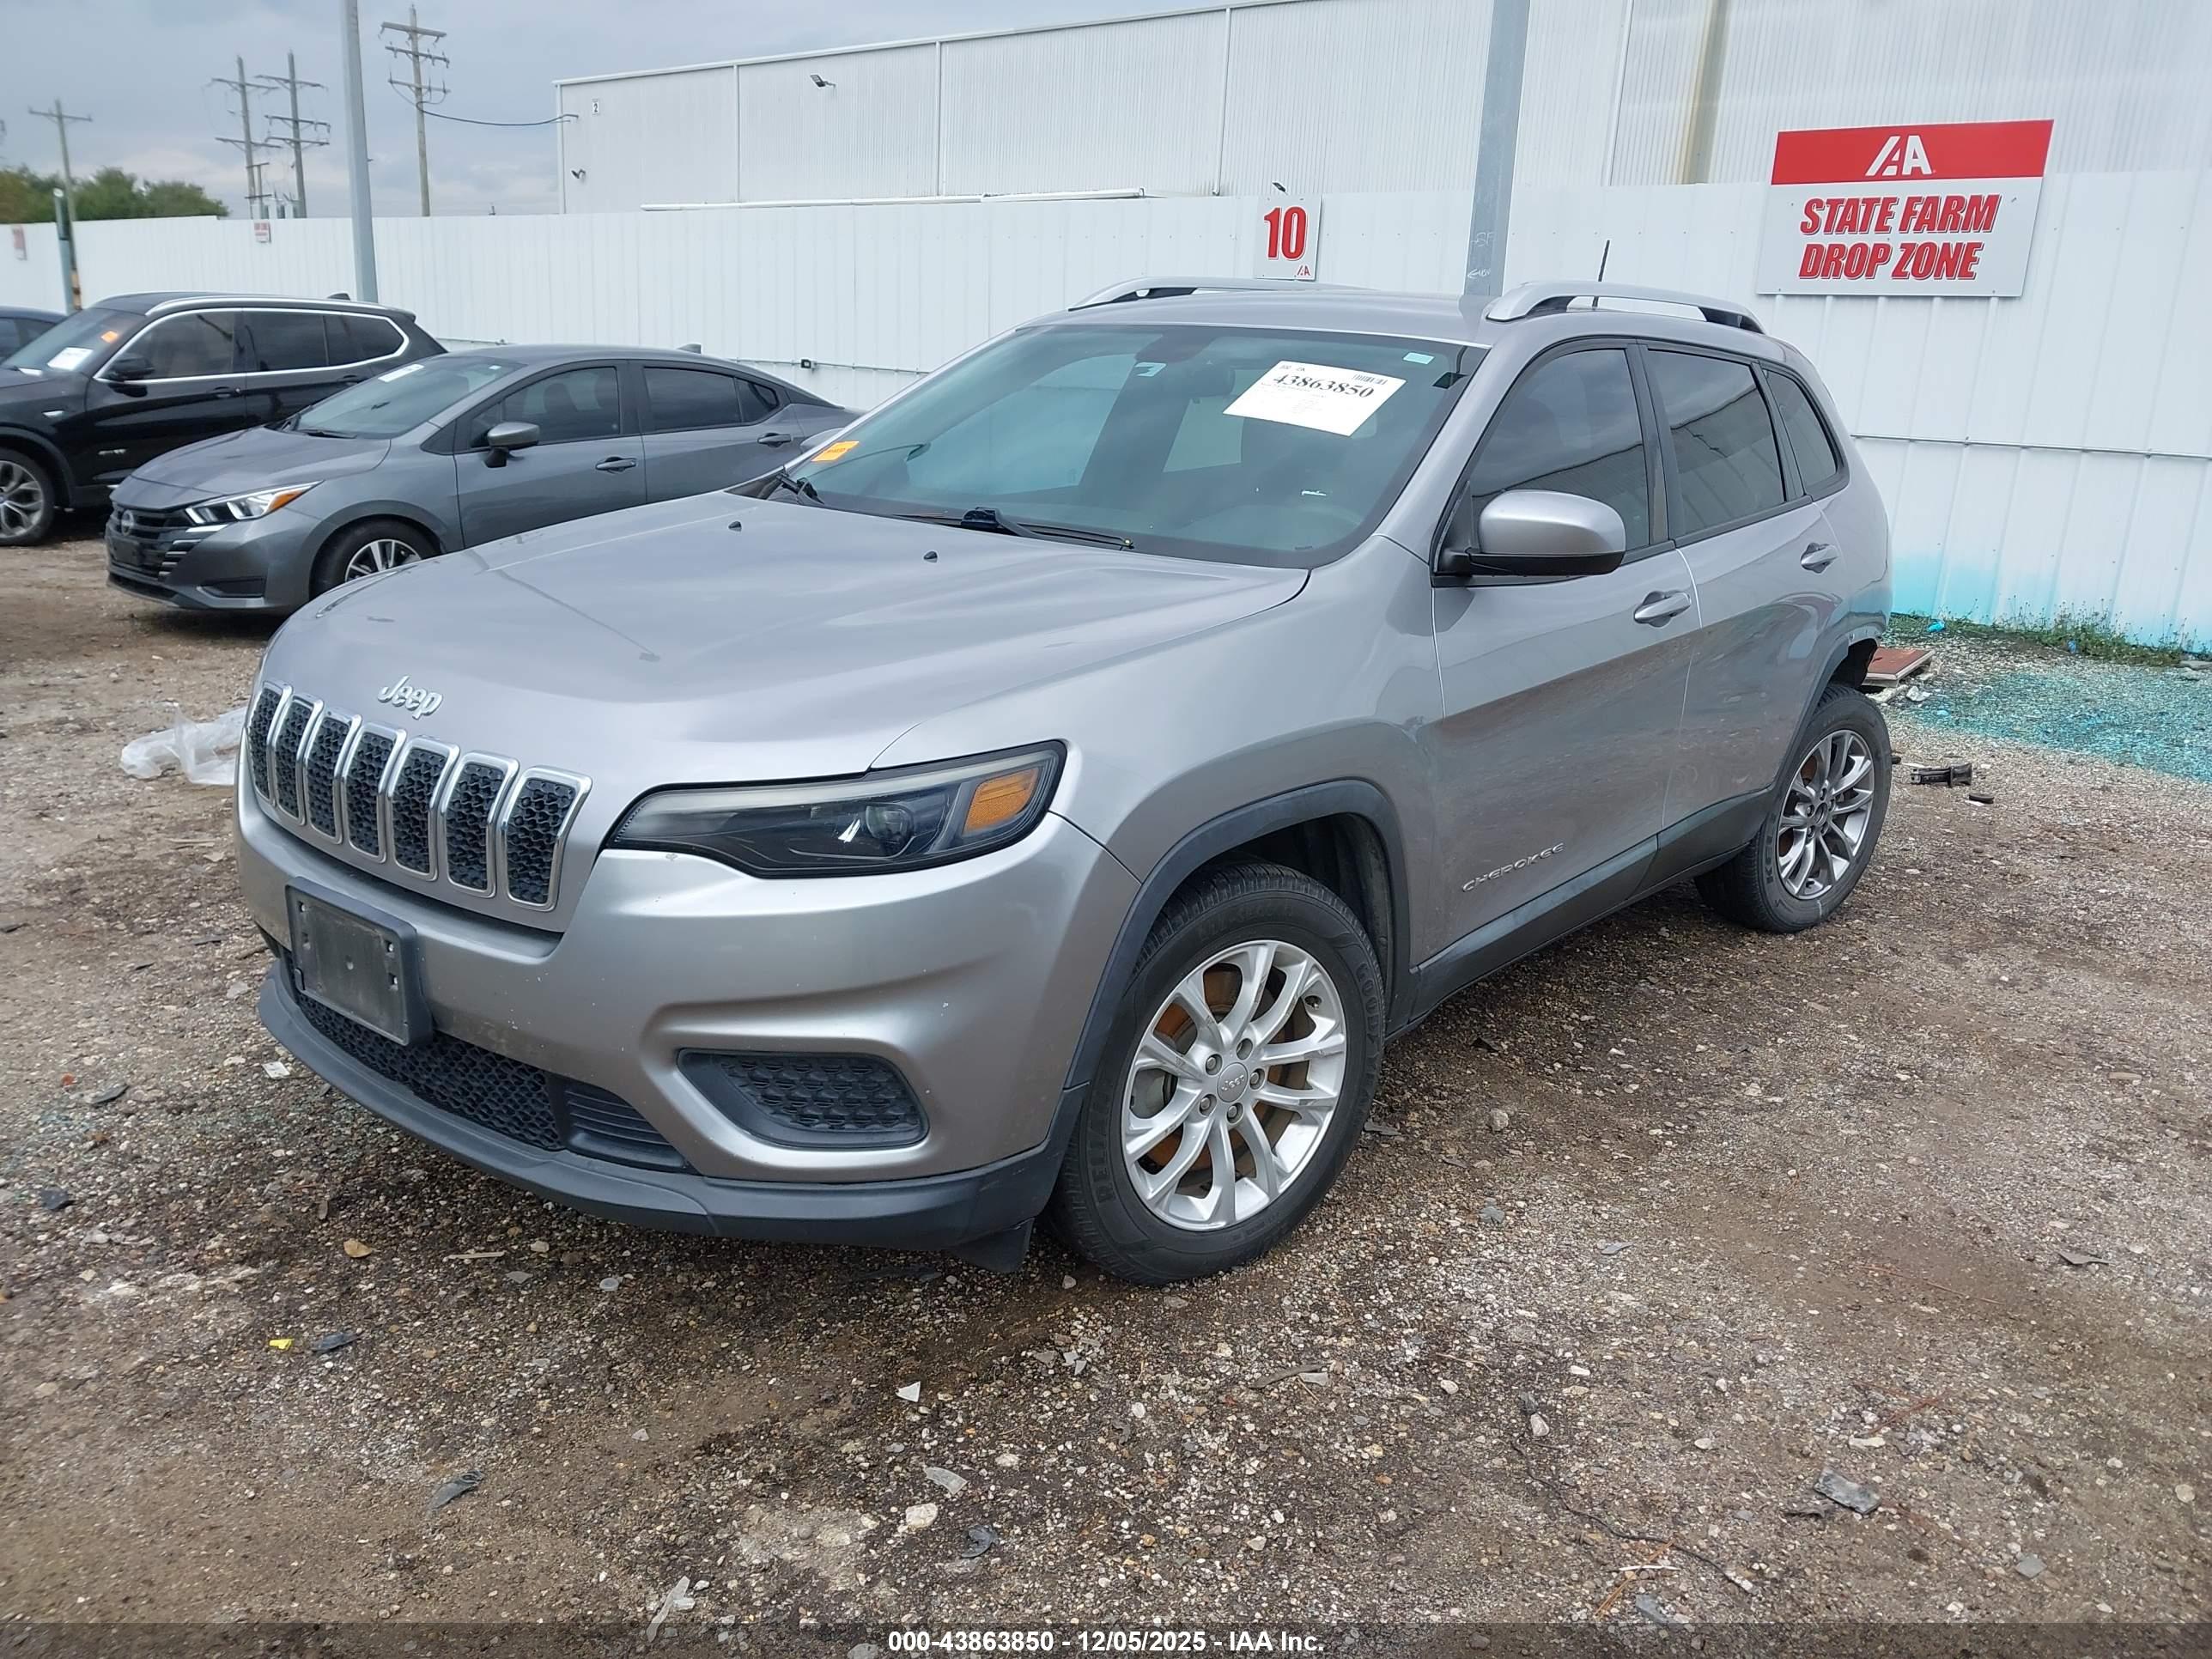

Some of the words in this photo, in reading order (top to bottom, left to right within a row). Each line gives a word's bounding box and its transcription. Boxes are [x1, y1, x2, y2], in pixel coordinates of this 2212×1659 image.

[1263, 206, 1308, 261] 10
[1800, 196, 1899, 235] STATE
[1899, 194, 2000, 234] FARM
[1798, 243, 1892, 280] DROP
[1891, 241, 1984, 280] ZONE
[1273, 374, 1375, 398] 43863850
[377, 675, 443, 720] Jeep
